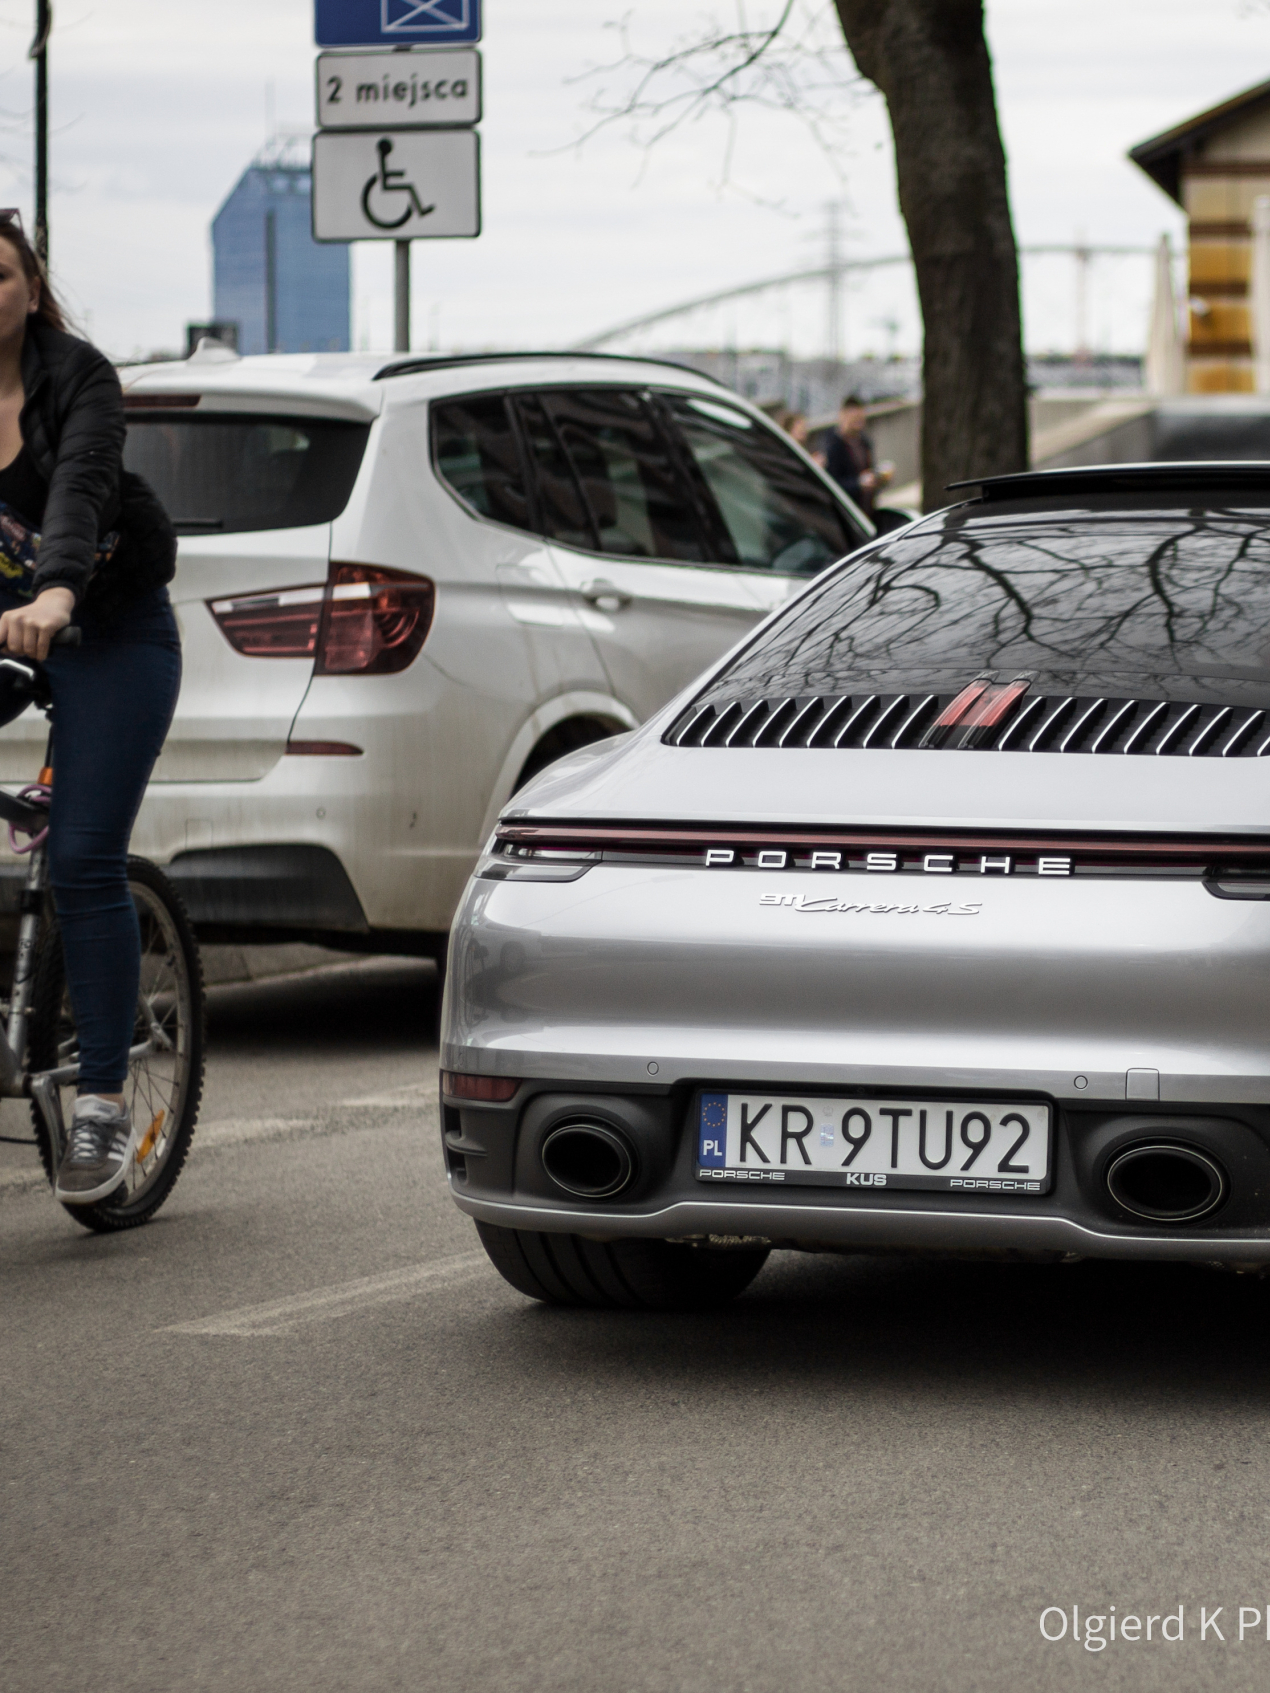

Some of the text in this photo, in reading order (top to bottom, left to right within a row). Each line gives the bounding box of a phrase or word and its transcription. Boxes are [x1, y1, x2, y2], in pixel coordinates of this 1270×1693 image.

[327, 72, 468, 109] 2 miejsca
[705, 849, 1072, 876] PORSCHE
[759, 893, 806, 906] 911
[795, 897, 920, 914] Carrera
[739, 1102, 1030, 1173] KR 9TU92
[703, 1140, 723, 1156] PL
[699, 1169, 785, 1181] PORSCHE
[846, 1173, 887, 1186] KUS
[950, 1179, 1041, 1191] PORSCHE
